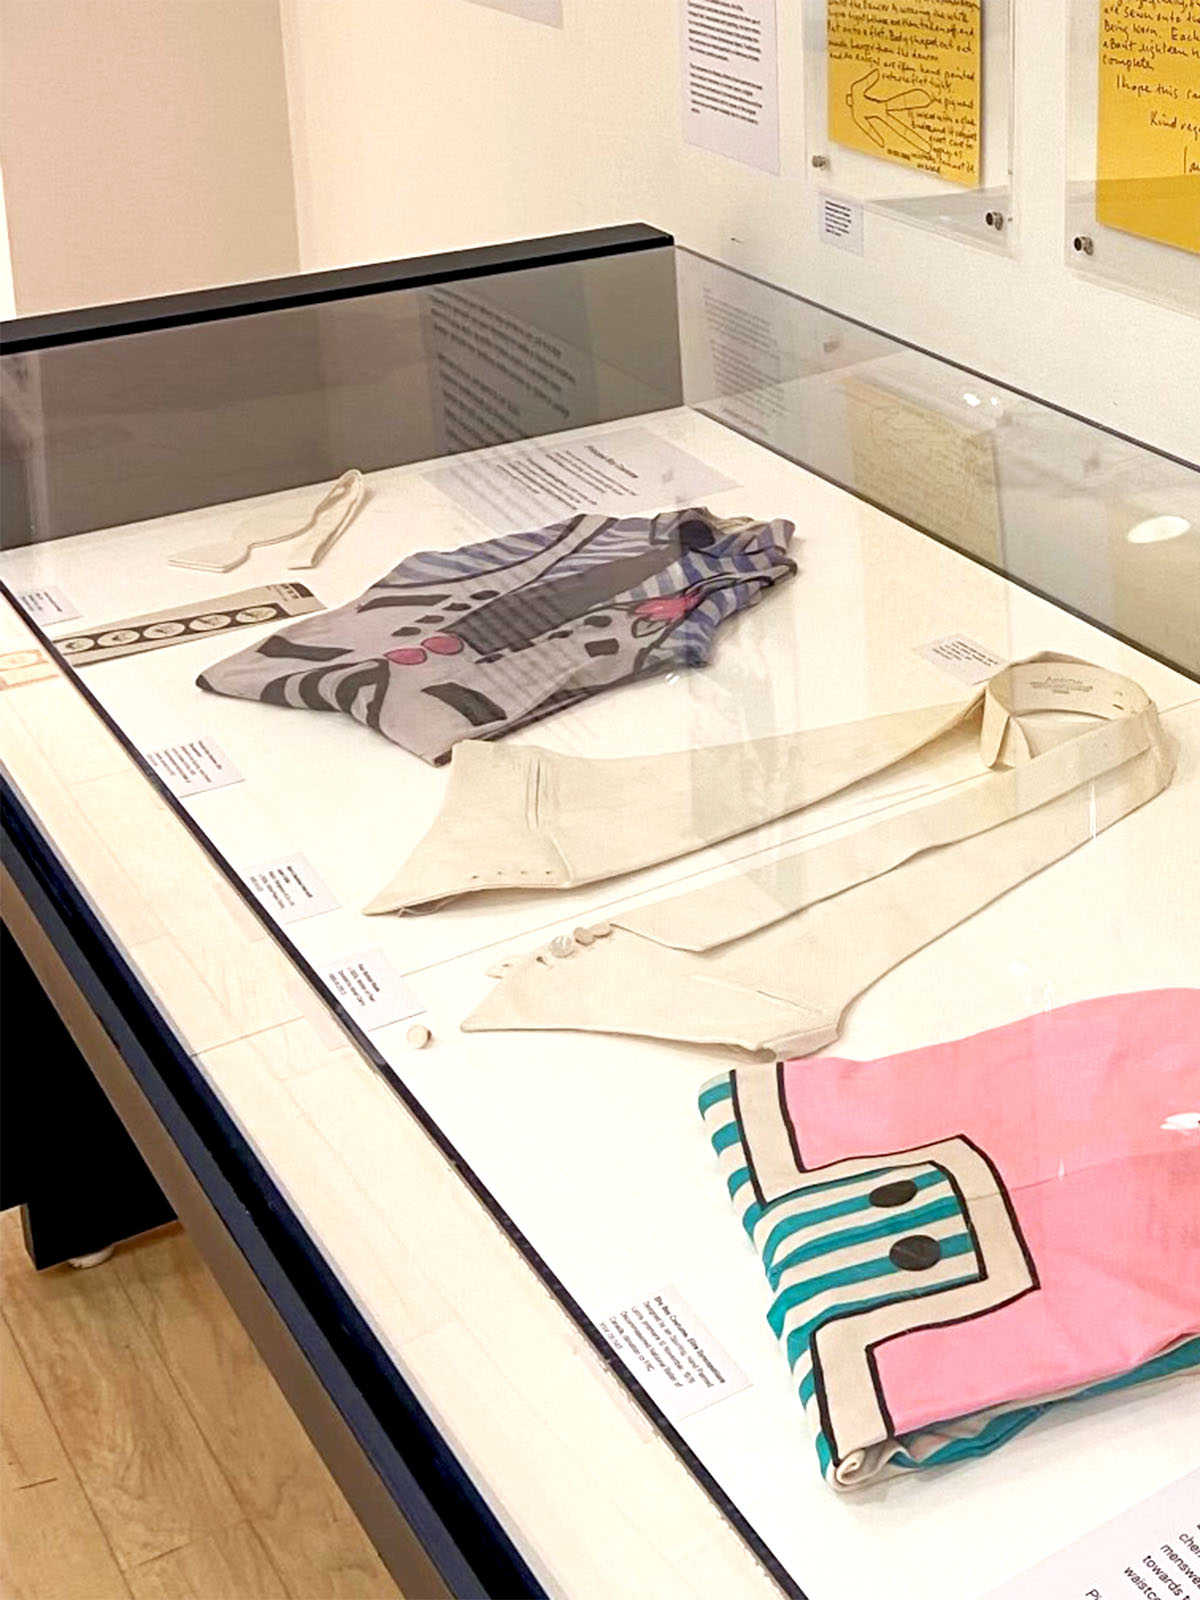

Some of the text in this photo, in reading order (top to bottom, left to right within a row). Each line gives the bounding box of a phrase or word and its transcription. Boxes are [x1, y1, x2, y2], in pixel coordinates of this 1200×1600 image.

[1170, 27, 1200, 42] Each
[1121, 74, 1152, 97] hope
[1156, 82, 1178, 100] this
[1150, 110, 1177, 129] Kind
[1142, 1554, 1183, 1596] towards
